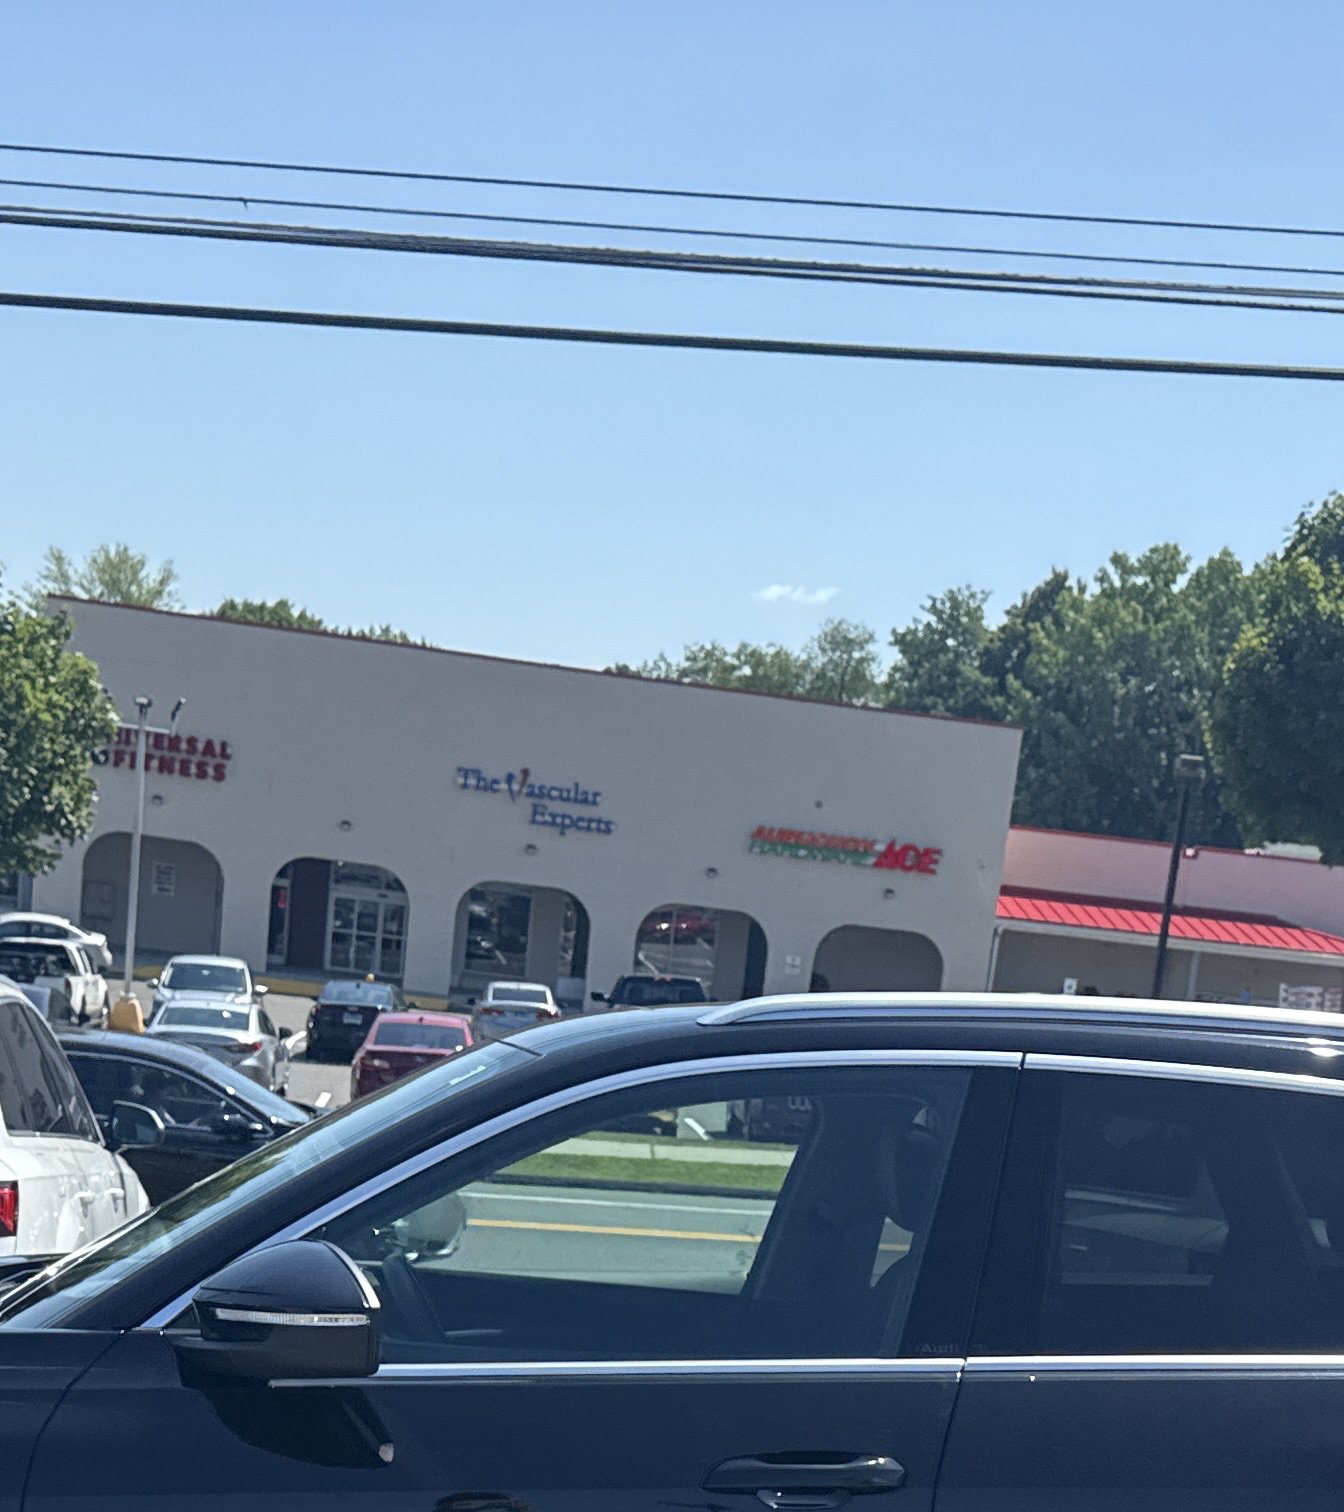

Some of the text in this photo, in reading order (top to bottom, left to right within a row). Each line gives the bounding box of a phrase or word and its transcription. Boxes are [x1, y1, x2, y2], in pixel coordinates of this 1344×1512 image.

[110, 727, 232, 760] IVERSAL
[112, 749, 227, 782] FITNESS
[457, 767, 602, 806] The Vascular
[530, 803, 615, 836] Experts
[873, 838, 943, 875] ACE
